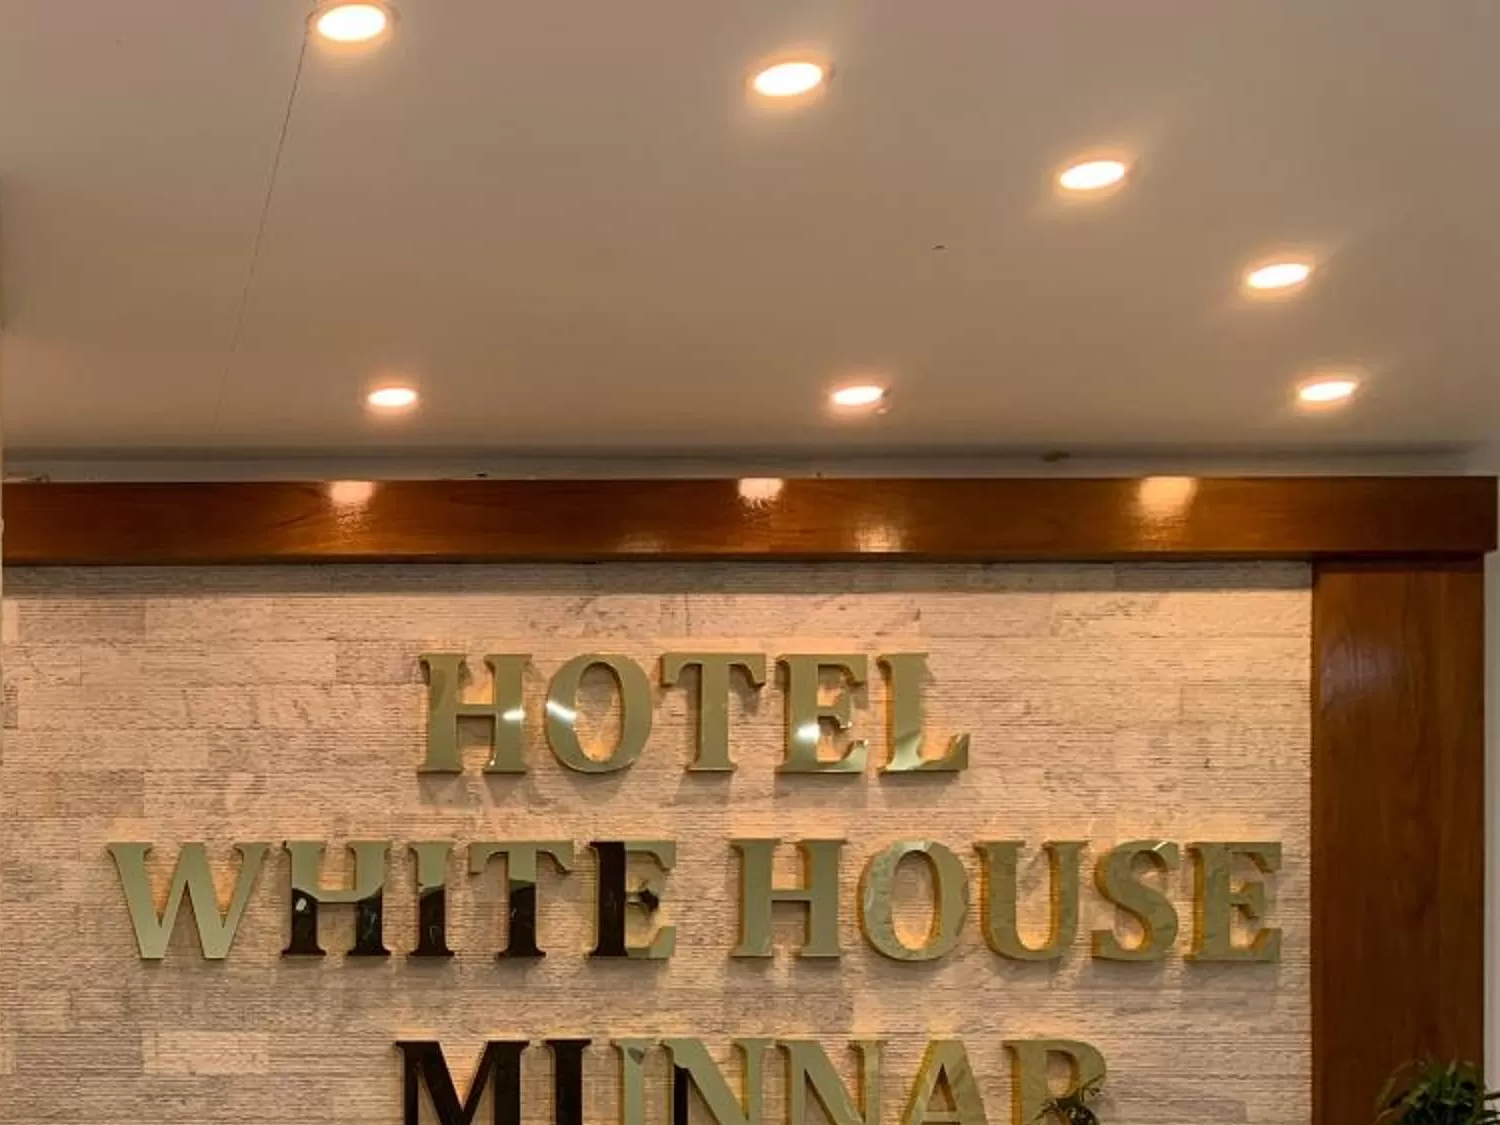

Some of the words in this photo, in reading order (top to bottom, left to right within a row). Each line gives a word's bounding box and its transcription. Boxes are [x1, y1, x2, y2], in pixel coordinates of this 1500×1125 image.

[418, 653, 969, 773] HOTEL
[107, 840, 677, 960] WHITE
[729, 838, 1283, 962] HOUSE
